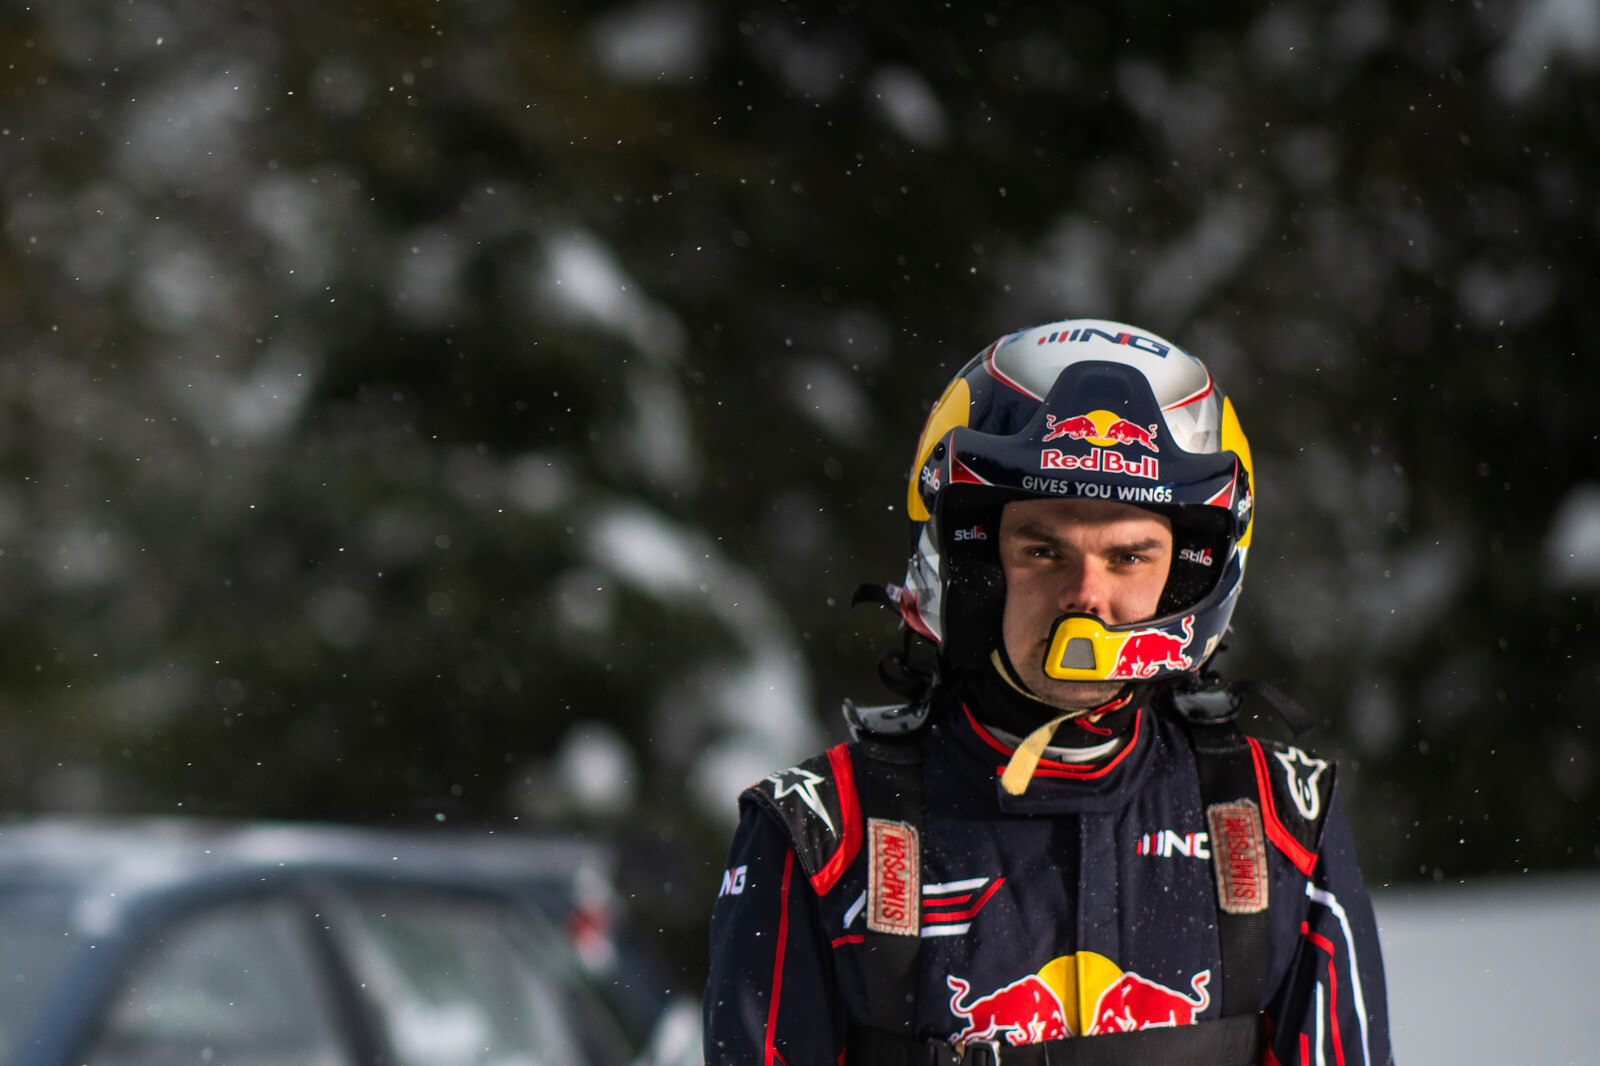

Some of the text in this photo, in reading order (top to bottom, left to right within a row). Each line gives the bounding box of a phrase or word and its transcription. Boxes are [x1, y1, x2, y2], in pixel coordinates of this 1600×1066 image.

[921, 465, 941, 491] Stilo
[1040, 447, 1160, 481] Red Bull
[1022, 475, 1173, 503] GIVES YOU WINGS
[953, 523, 988, 541] Stilo
[1178, 548, 1213, 567] Stilo
[1223, 817, 1256, 901] SIMPSON
[881, 833, 906, 922] SIMPSON
